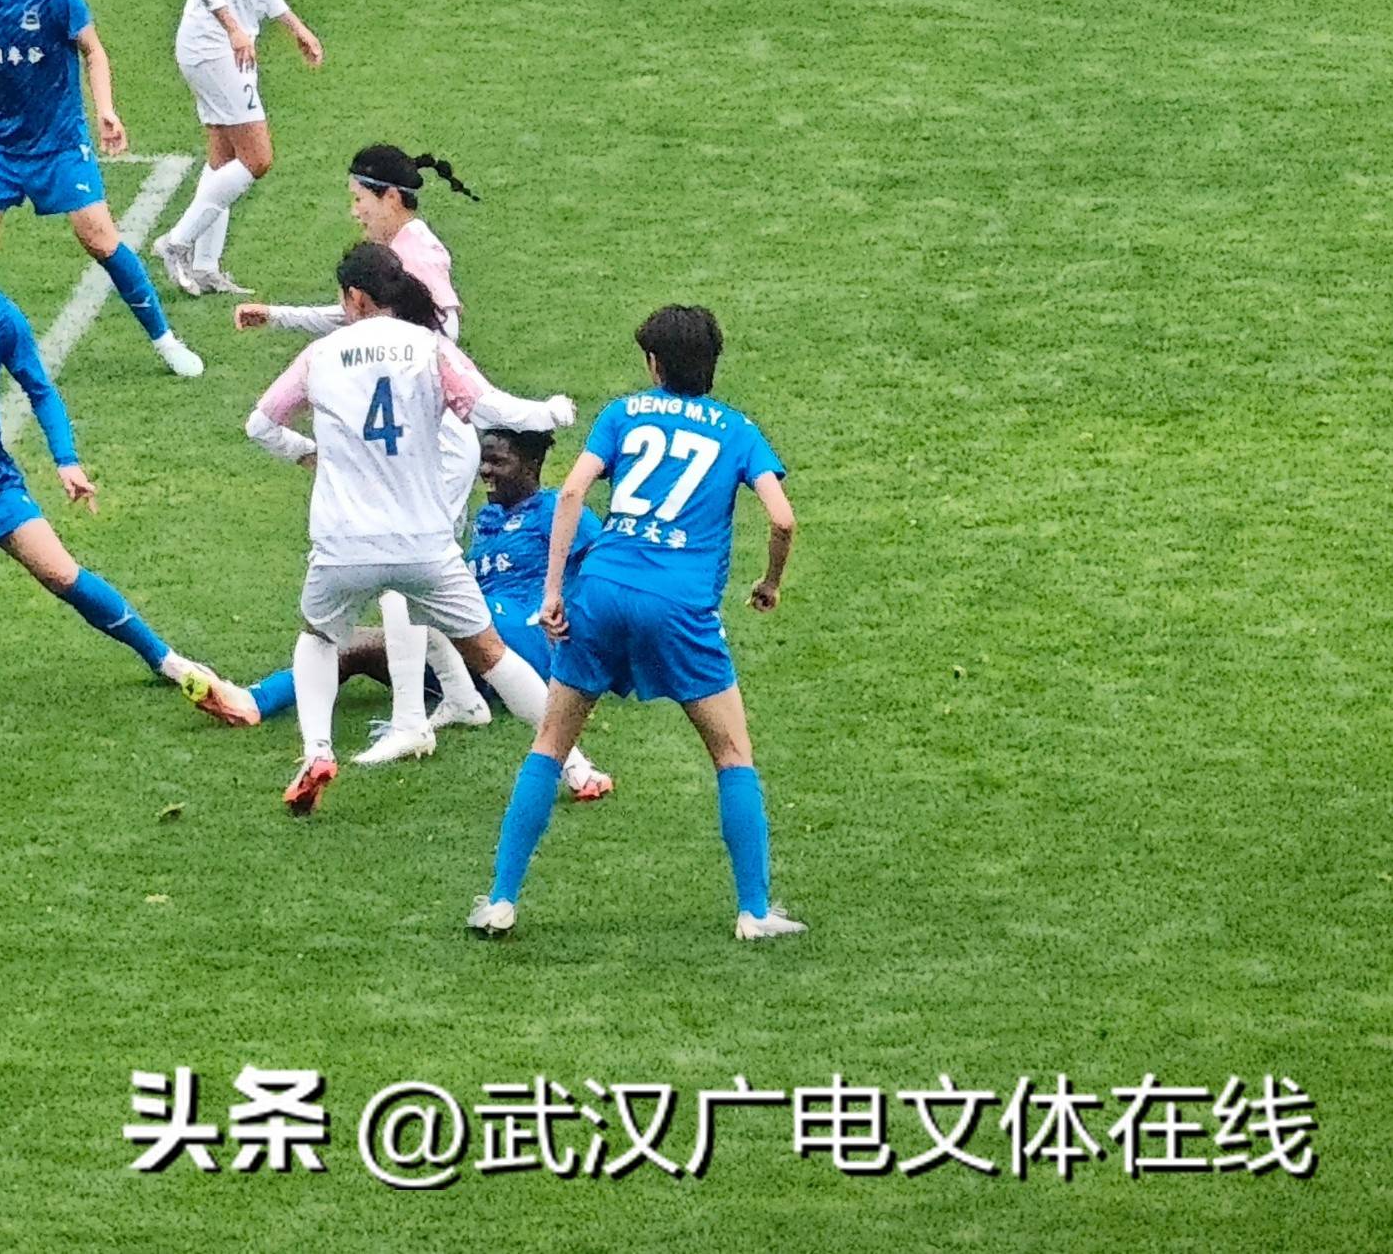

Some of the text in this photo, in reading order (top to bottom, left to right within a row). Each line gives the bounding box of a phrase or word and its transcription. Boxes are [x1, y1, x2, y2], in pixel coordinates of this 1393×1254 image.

[243, 83, 257, 110] 2
[340, 345, 386, 368] WANG
[362, 375, 404, 456] 4
[684, 401, 728, 430] M.Y.
[609, 423, 721, 523] 27
